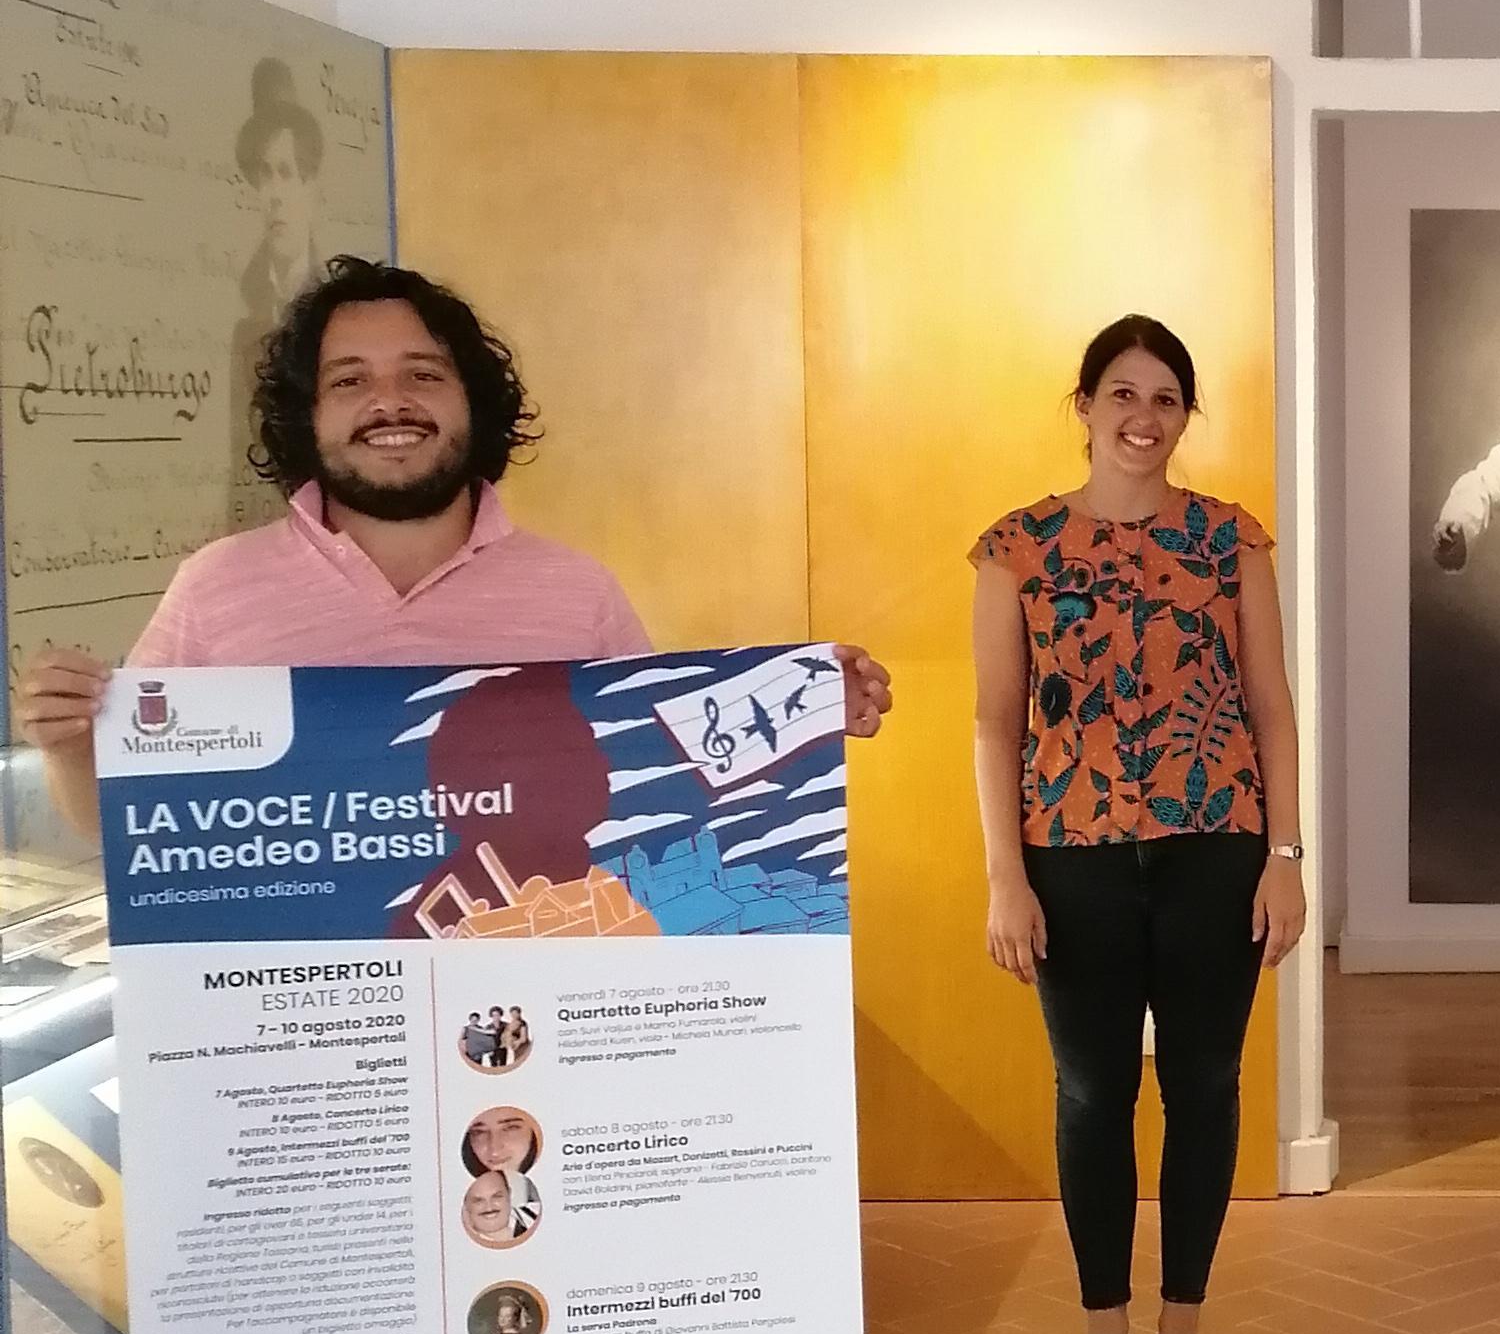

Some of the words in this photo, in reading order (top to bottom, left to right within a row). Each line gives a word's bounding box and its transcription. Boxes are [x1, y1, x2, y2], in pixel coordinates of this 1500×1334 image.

[122, 731, 263, 756] Montespertoli
[126, 803, 179, 836] LA
[188, 794, 314, 833] VOCE
[346, 781, 513, 823] Festival
[127, 834, 321, 876] Amedeo
[332, 823, 446, 863] Bassi
[130, 884, 249, 908] undicesima
[254, 878, 336, 900] edizione
[203, 959, 404, 990] MONTESPERTOLI
[261, 988, 341, 1012] ESTATE
[347, 984, 405, 1006] 2020
[619, 986, 664, 1000] agosto
[557, 1004, 641, 1022] Quartetto
[644, 996, 718, 1017] Euphoria
[722, 995, 767, 1008] Show
[256, 1024, 266, 1036] 7
[281, 1021, 299, 1035] 10
[302, 1018, 362, 1036] agosto
[365, 1014, 405, 1028] 2020
[148, 1051, 194, 1063] Piazza
[214, 1040, 297, 1056] Machiavelli
[309, 1031, 406, 1048] Montespertoli
[355, 1056, 408, 1072] Biglietti
[561, 1125, 608, 1138] sabato
[622, 1120, 668, 1135] agosto
[562, 1139, 641, 1155] Concerto
[644, 1134, 689, 1149] Lirico
[566, 1284, 633, 1299] domenica
[648, 1279, 693, 1294] agosto
[567, 1296, 655, 1317] Intermezzi
[658, 1292, 697, 1308] buffi
[700, 1290, 725, 1304] del
